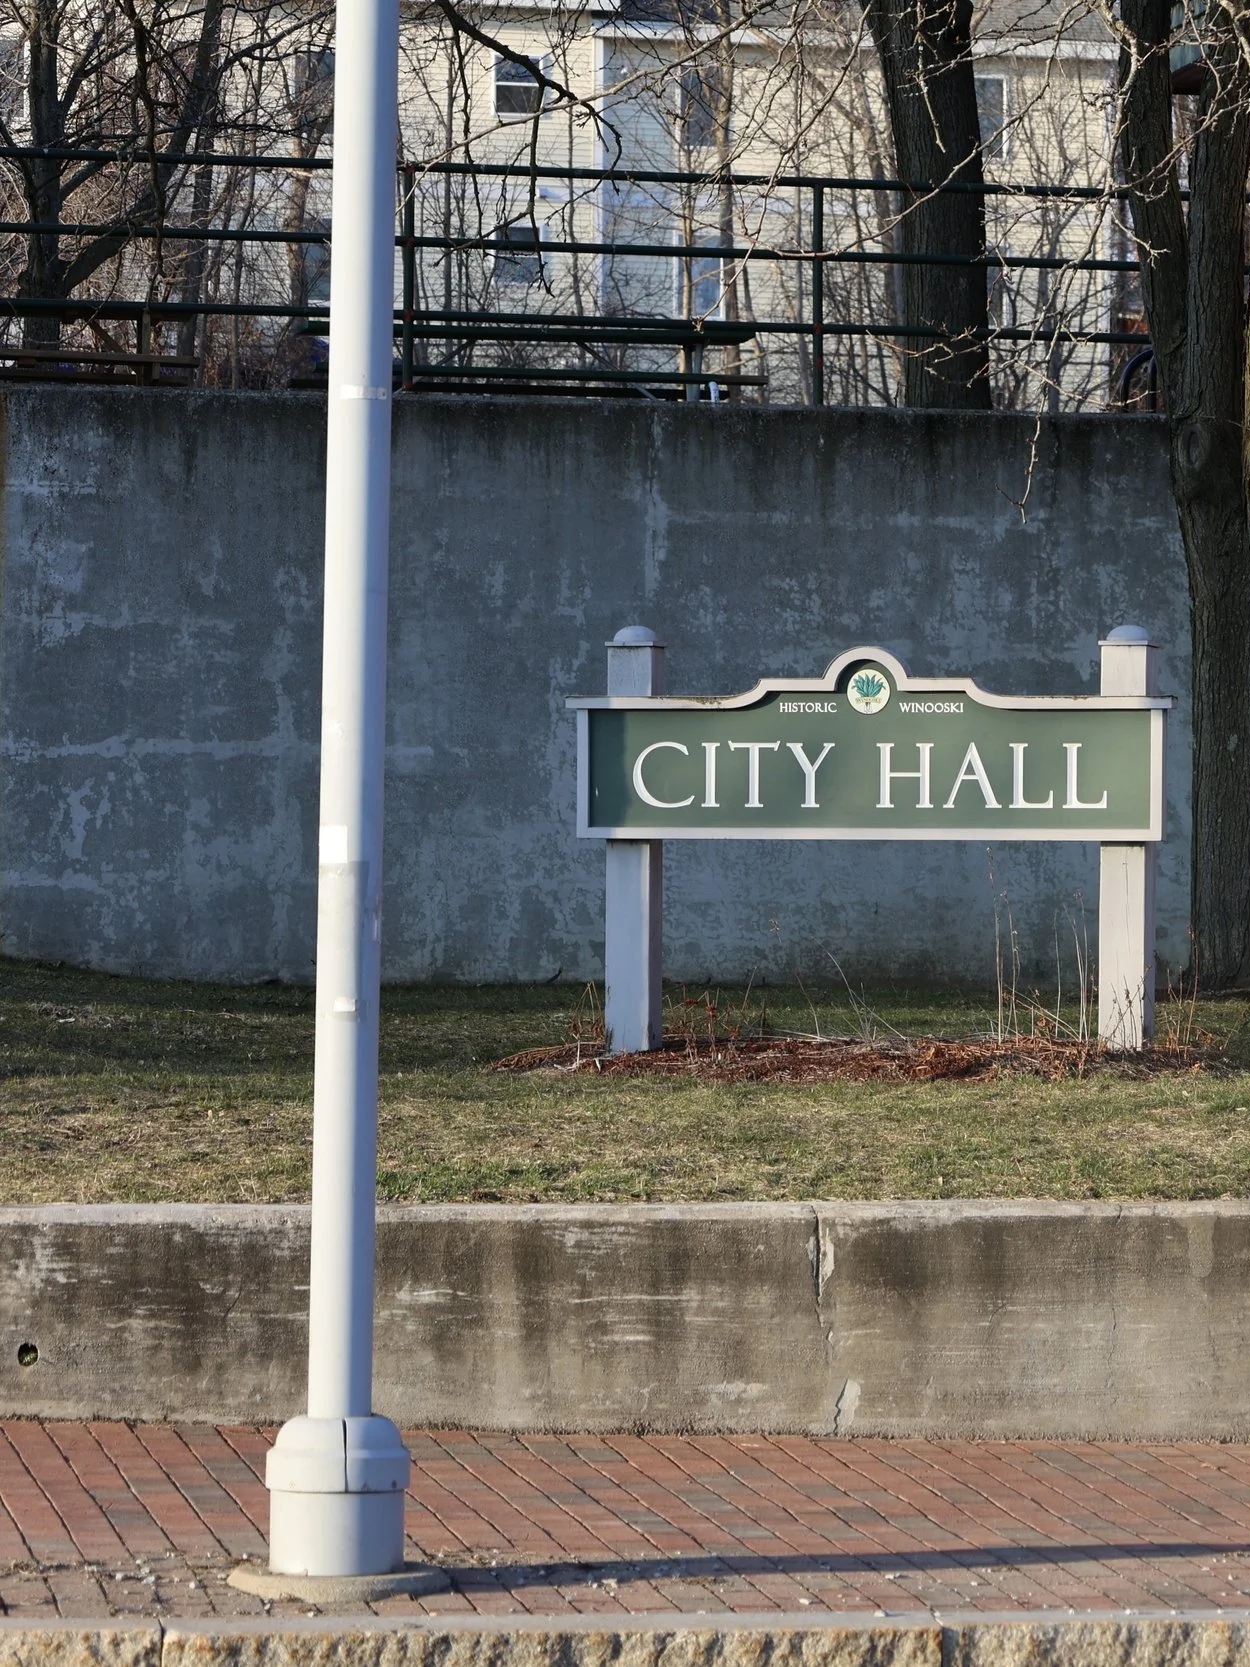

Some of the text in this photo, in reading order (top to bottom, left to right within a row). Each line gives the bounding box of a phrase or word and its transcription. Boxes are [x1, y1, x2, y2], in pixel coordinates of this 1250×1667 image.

[779, 702, 964, 713] HISTORIC WINOOSKI
[632, 740, 1108, 809] CITY HALL
